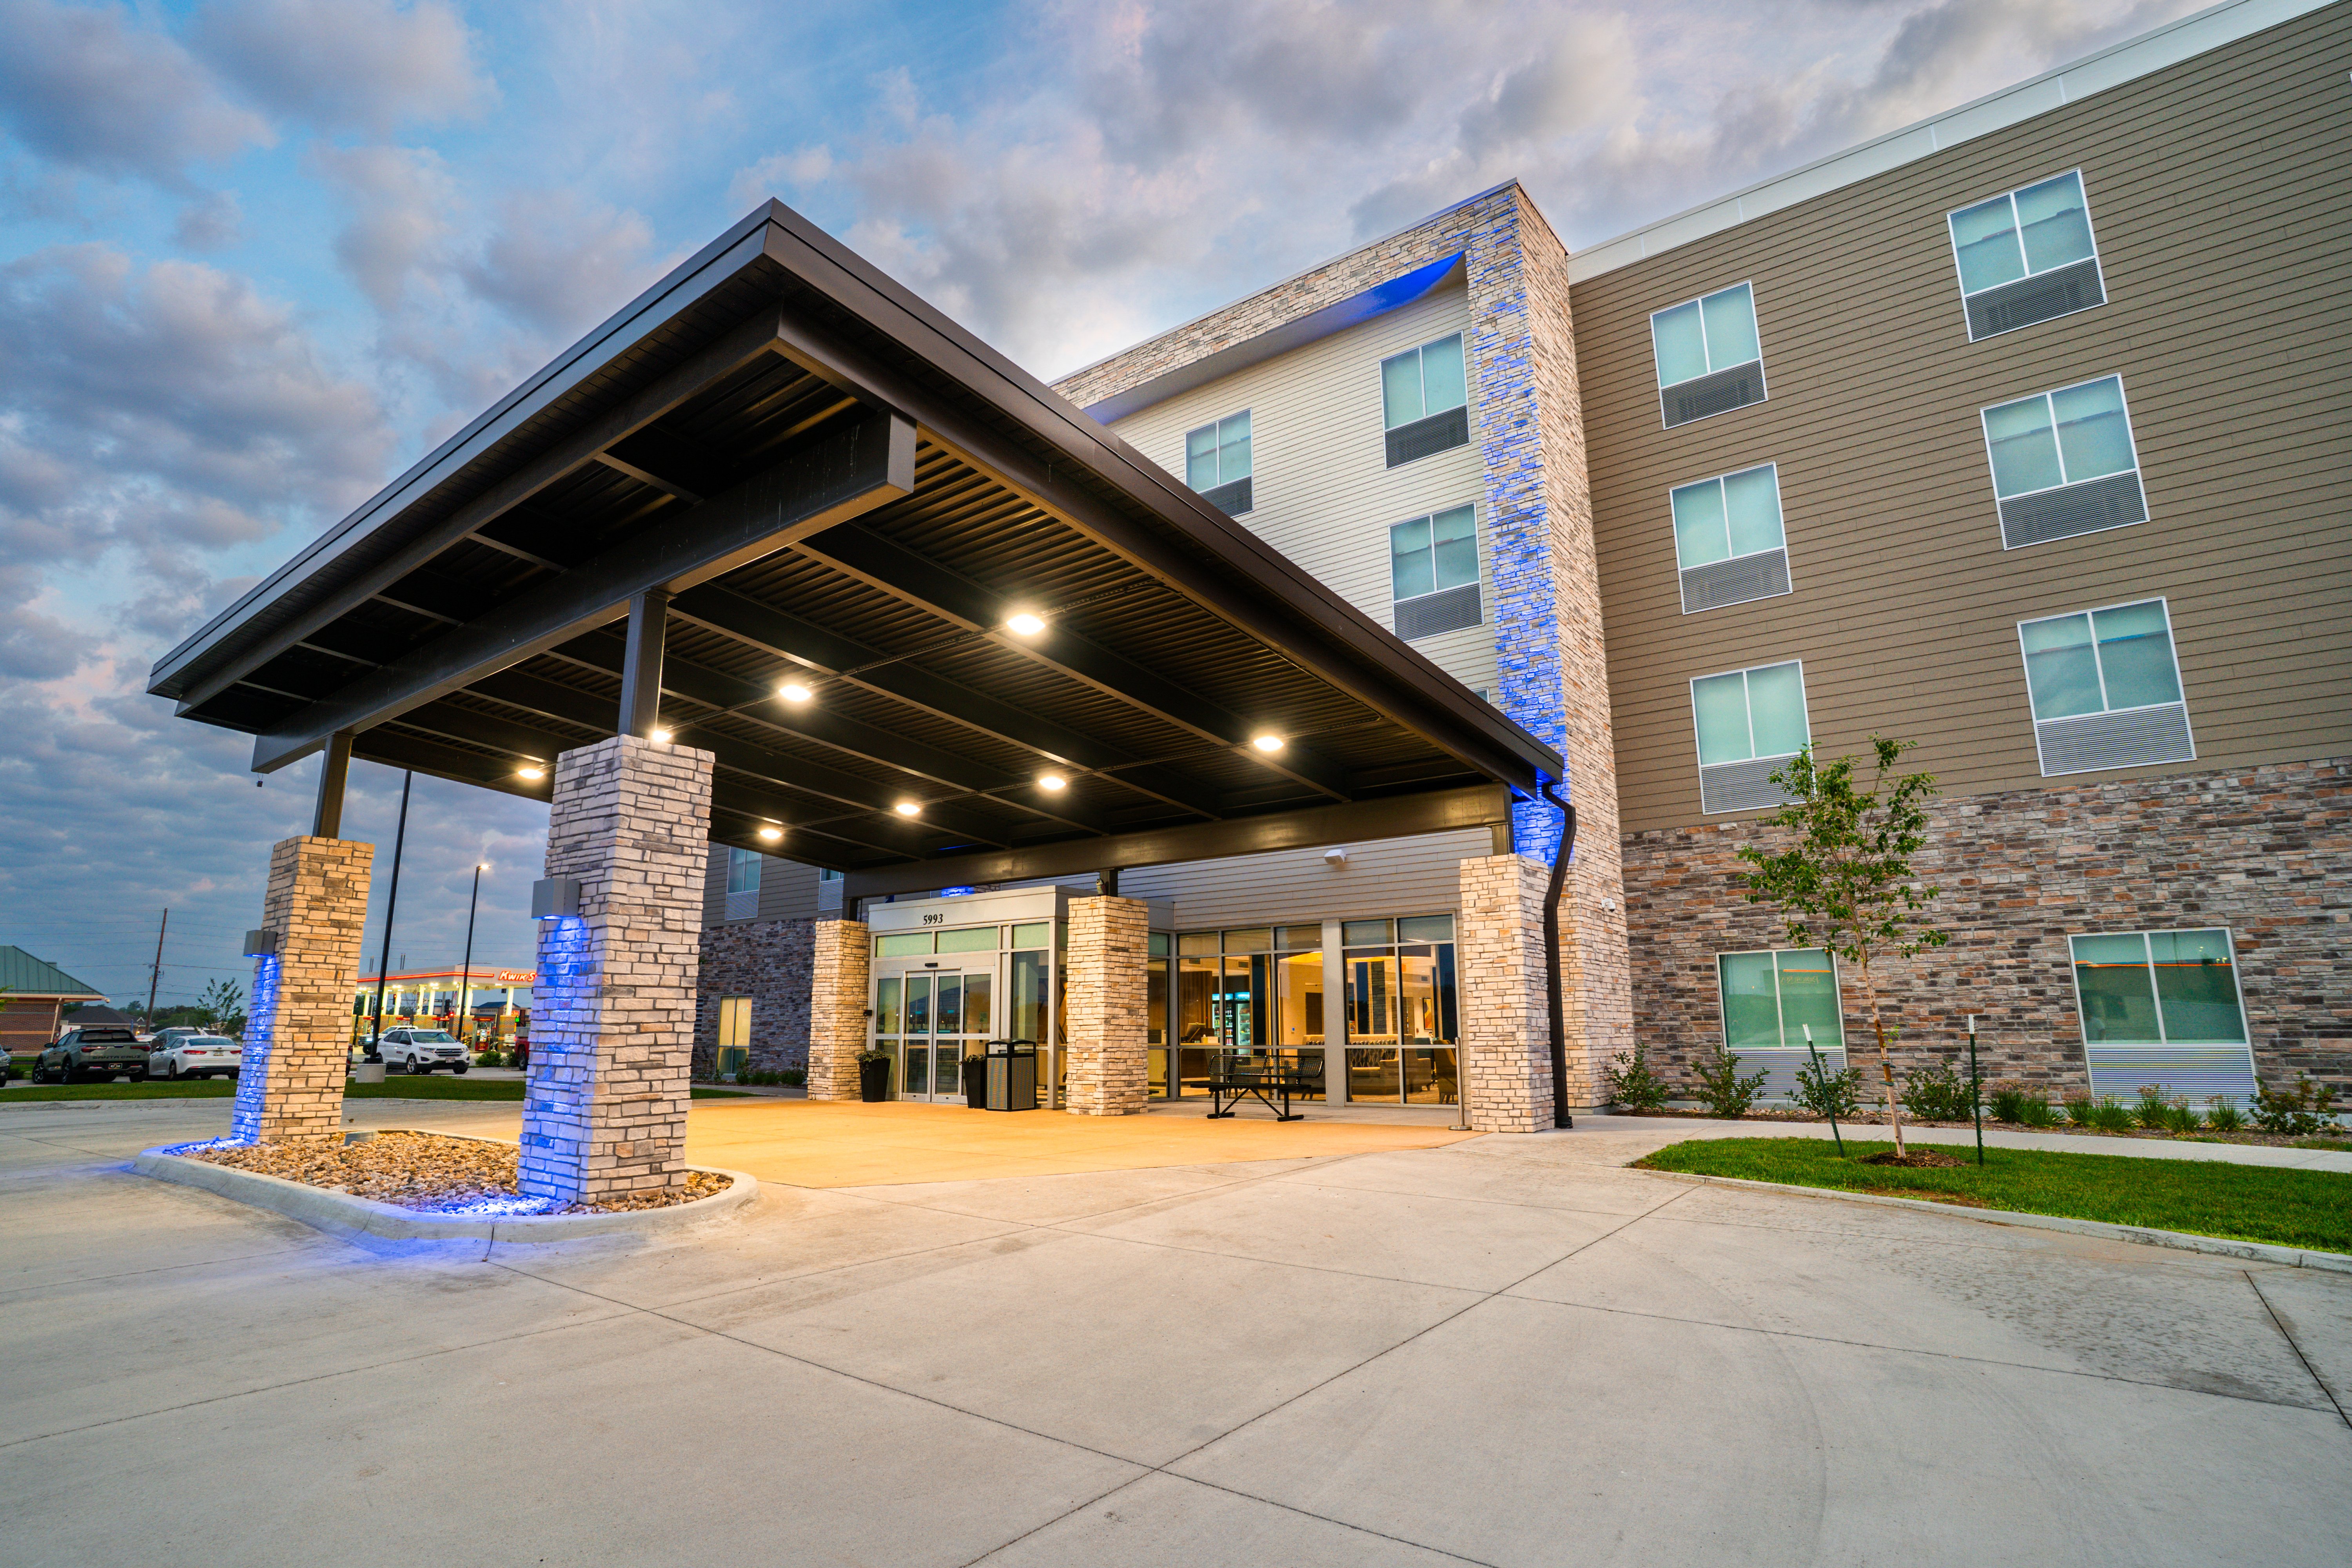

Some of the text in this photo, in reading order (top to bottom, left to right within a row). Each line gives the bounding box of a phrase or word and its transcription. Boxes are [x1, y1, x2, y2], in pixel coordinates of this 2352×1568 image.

[923, 913, 943, 925] 5993
[499, 971, 538, 982] KWIK S
